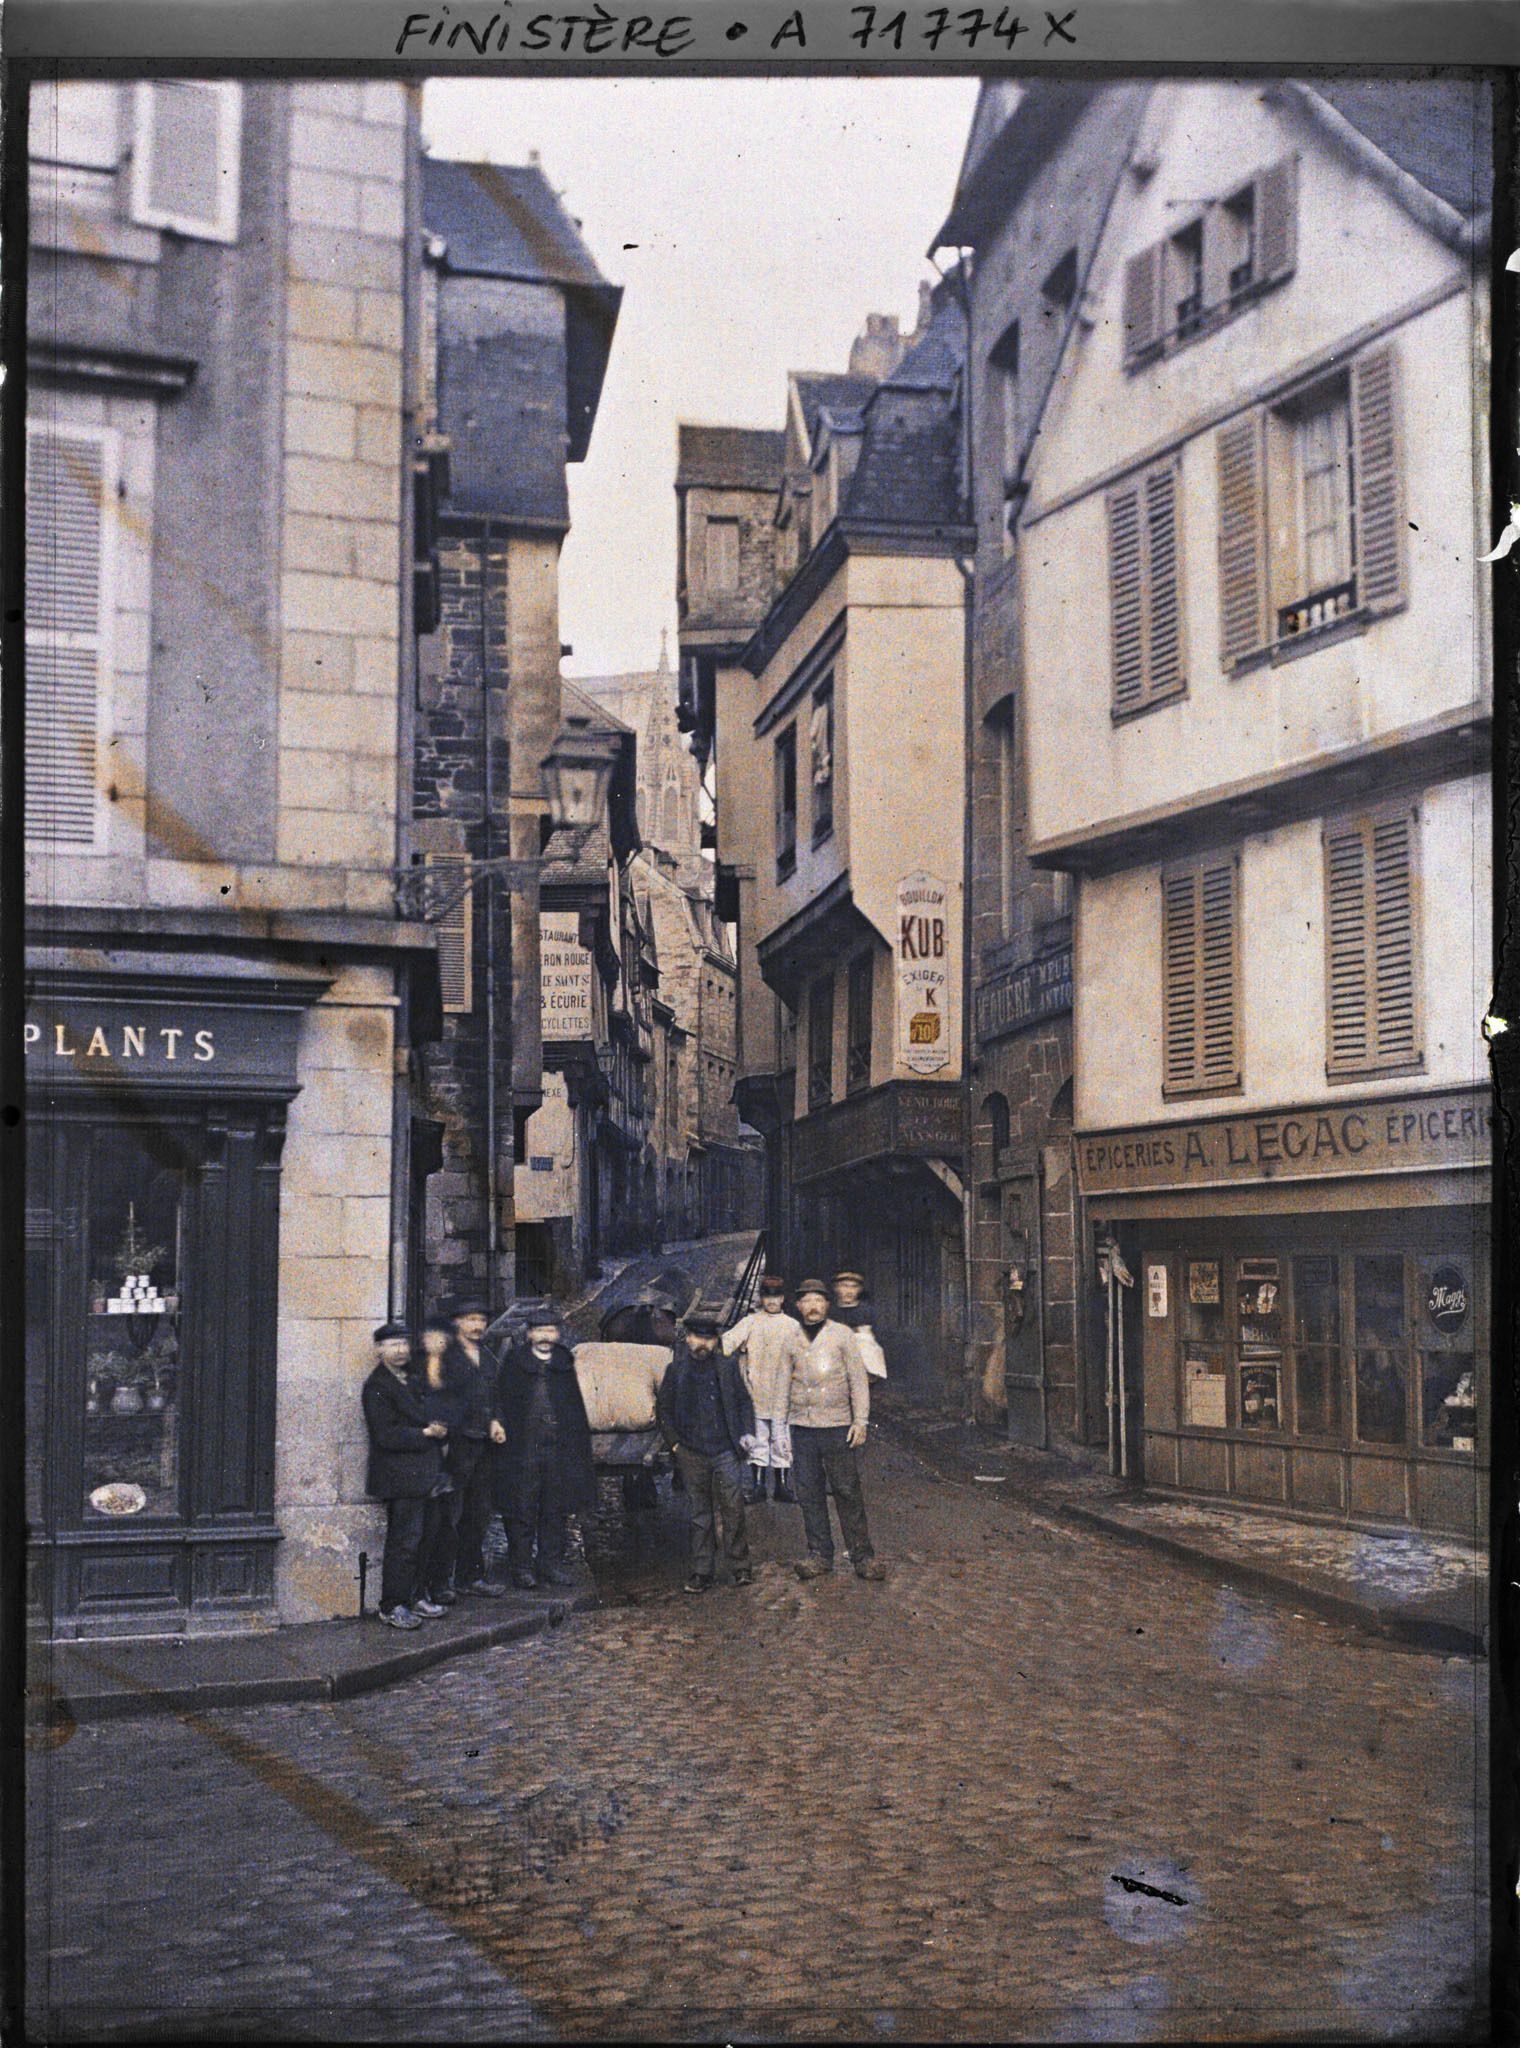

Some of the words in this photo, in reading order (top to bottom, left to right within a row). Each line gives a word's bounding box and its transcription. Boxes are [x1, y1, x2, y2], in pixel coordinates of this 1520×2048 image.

[901, 915, 944, 959] KUB
[564, 952, 590, 966] ROUGE
[902, 970, 945, 986] EXIGER
[926, 988, 936, 1005] K
[24, 1024, 215, 1061] PLANTS
[1085, 1140, 1175, 1172] ÉPICERIES
[1428, 1286, 1467, 1313] Maggi
